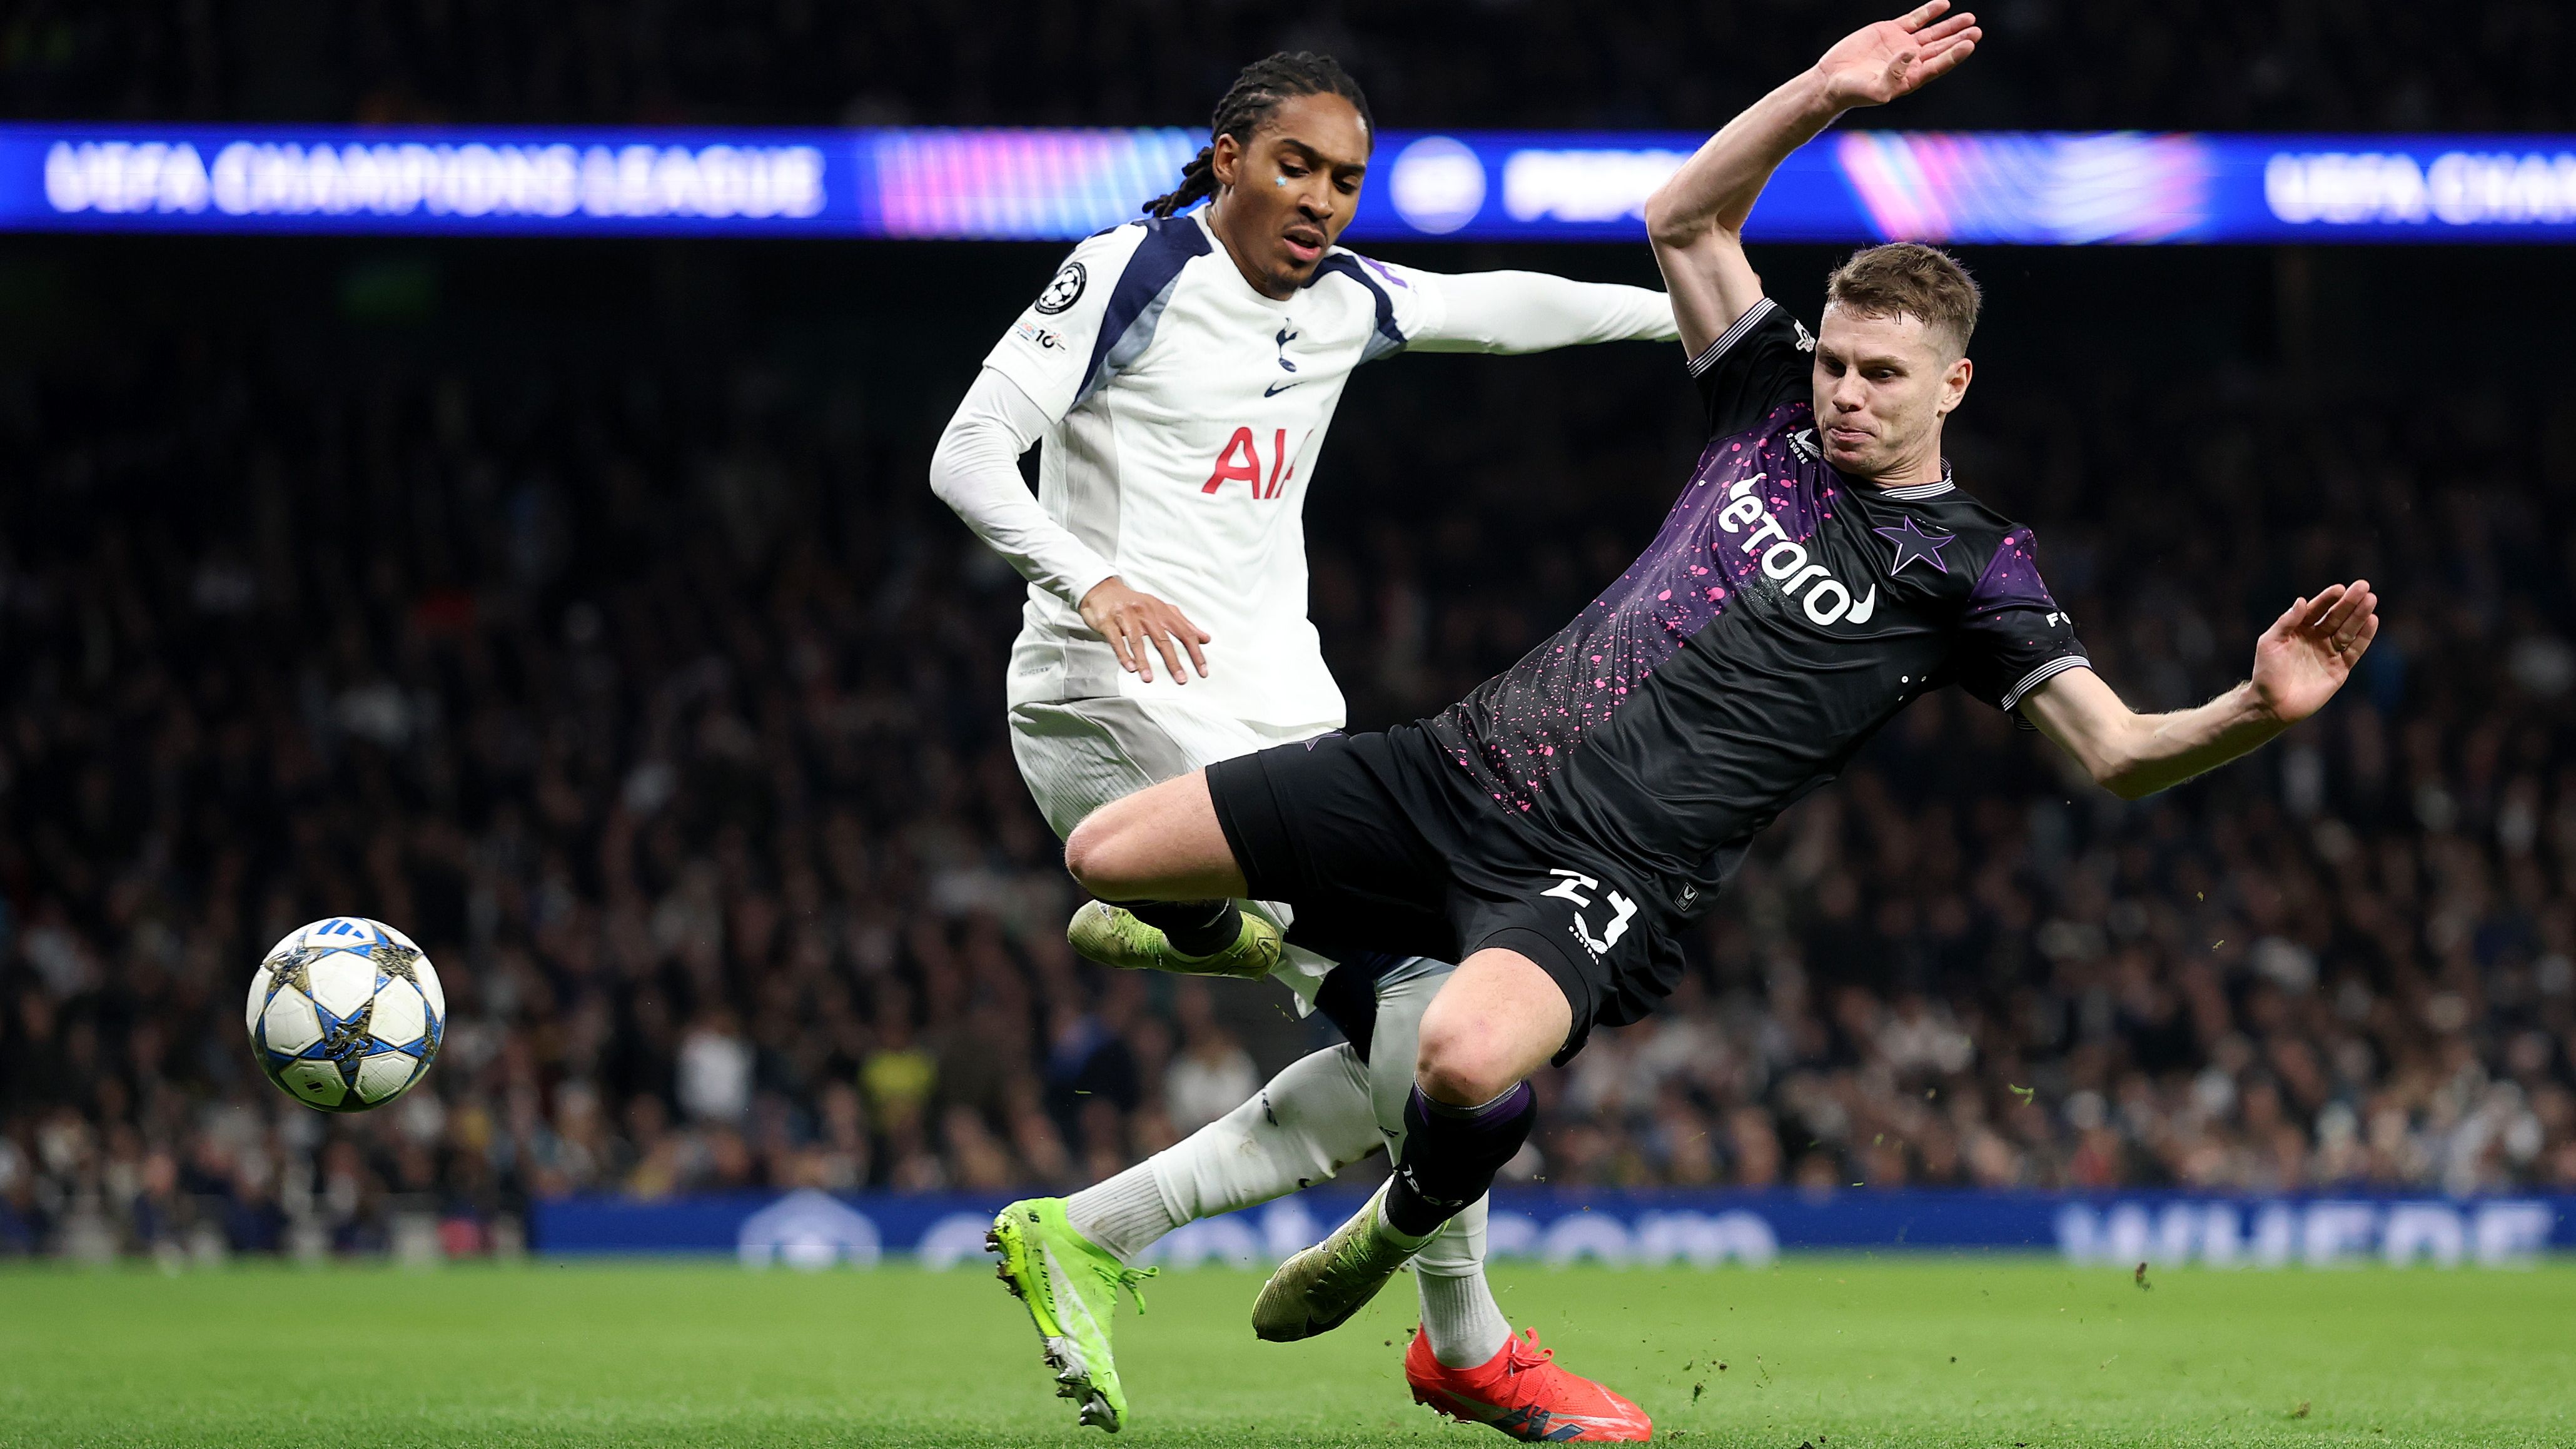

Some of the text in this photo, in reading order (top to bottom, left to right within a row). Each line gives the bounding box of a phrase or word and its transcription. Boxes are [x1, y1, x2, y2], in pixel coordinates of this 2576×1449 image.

[45, 143, 822, 216] UEFA CHAMPIONS LEAGUE
[2265, 153, 2425, 223] UEFA
[1201, 427, 1313, 500] AI
